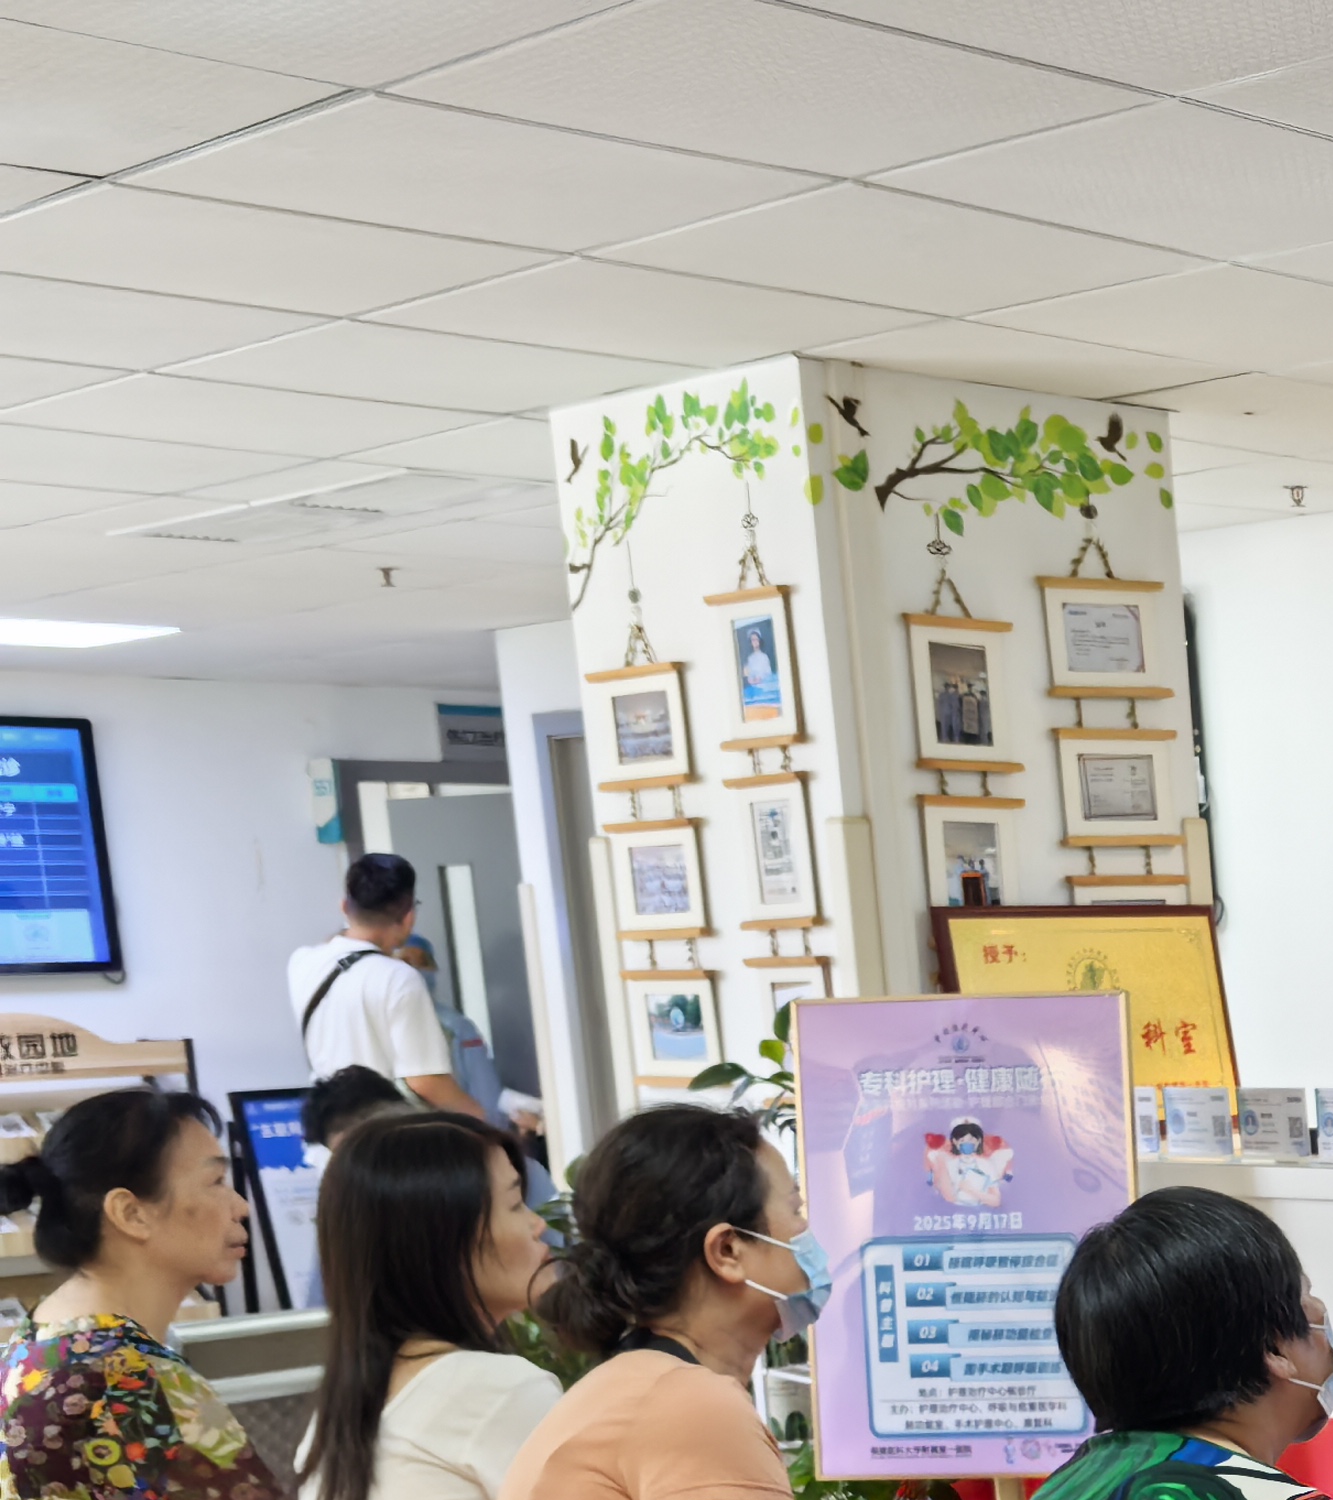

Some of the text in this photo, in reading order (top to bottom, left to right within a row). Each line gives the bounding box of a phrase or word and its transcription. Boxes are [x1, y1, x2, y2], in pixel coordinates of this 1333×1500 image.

[860, 1066, 1068, 1095] 专科护理·健康随
[914, 1212, 1023, 1231] 2025年9月17日
[914, 1254, 930, 1267] 01
[917, 1288, 934, 1300] 02
[919, 1326, 936, 1338] 03
[921, 1360, 938, 1372] 04
